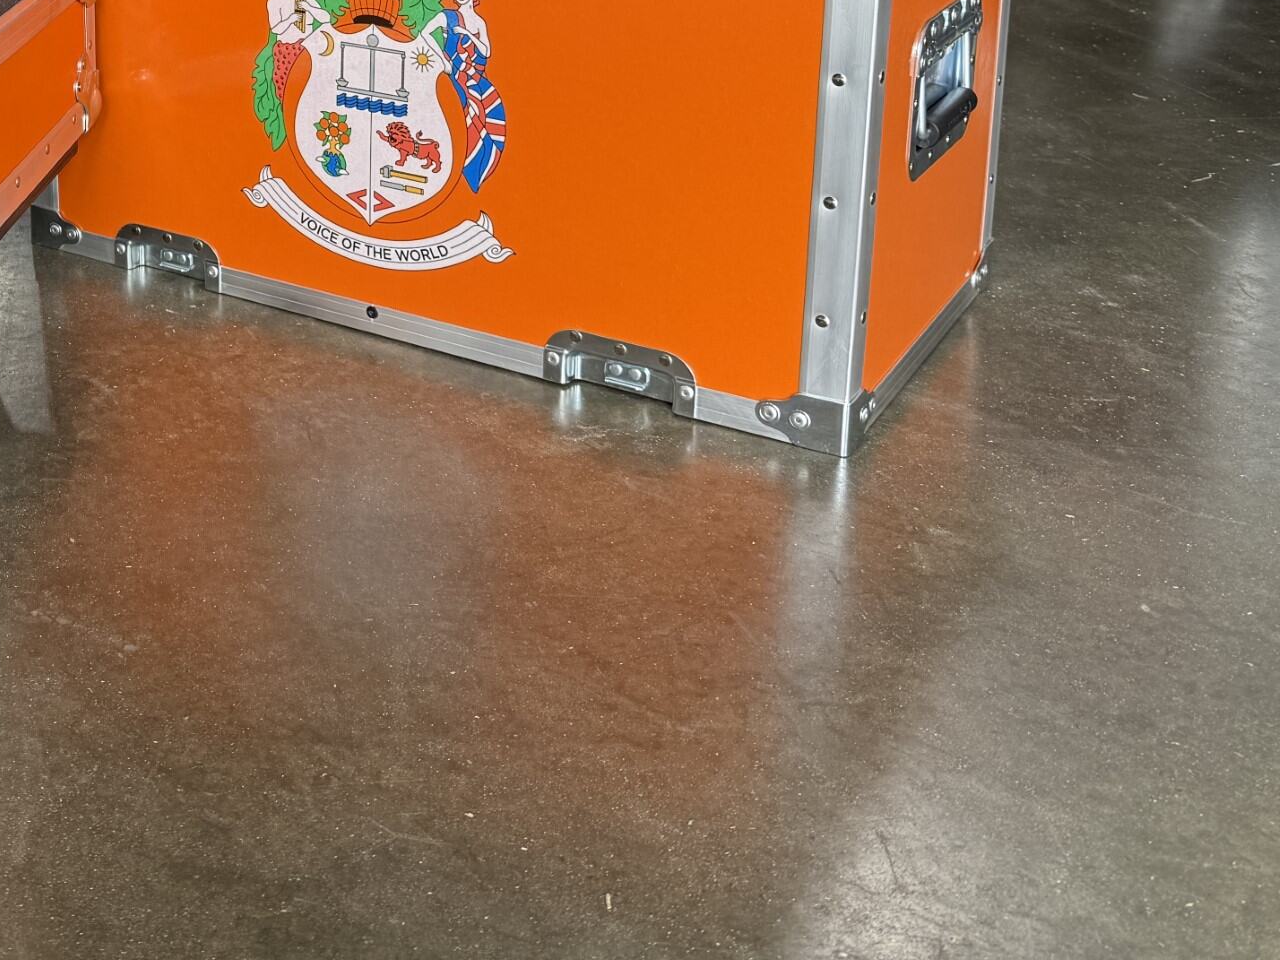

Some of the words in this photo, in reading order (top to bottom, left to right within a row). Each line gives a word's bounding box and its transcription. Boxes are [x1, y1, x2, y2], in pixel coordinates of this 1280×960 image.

[299, 212, 339, 245] VOICE
[341, 237, 361, 253] OF
[364, 244, 392, 260] THE
[395, 245, 449, 262] WORLD
